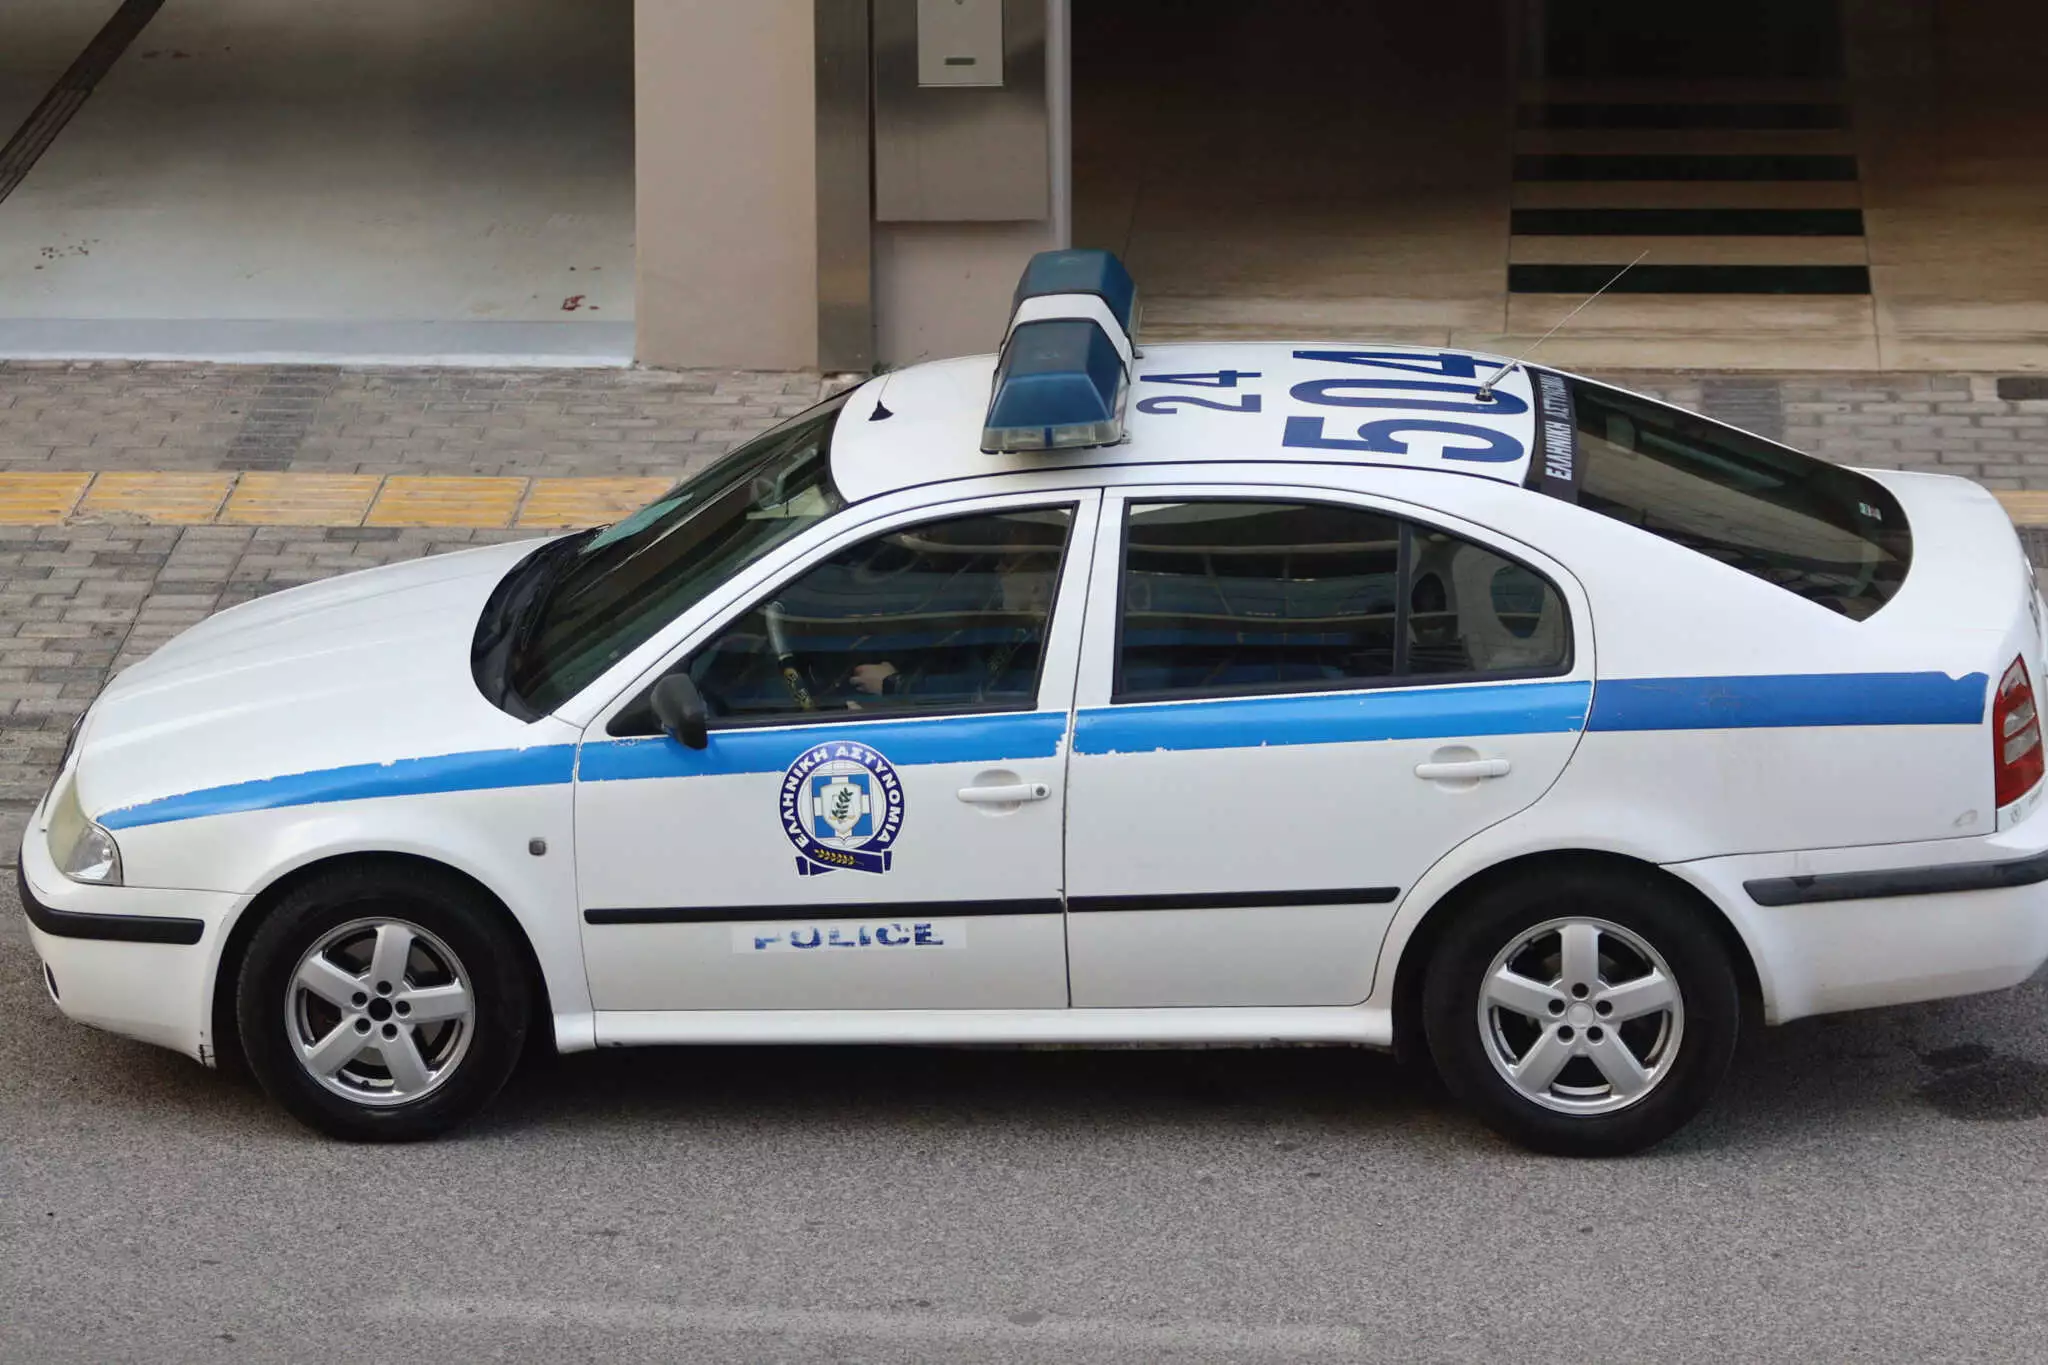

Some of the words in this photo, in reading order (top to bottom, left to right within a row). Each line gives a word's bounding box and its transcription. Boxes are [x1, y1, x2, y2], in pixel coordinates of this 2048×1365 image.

[1136, 370, 1262, 415] 24
[1282, 350, 1528, 463] 504
[1544, 420, 1572, 481] ΕΛΛΗΝΙΚΗ
[782, 747, 829, 849] ΕΛΛΗΝΙΚΗ
[834, 745, 901, 843] ΑΣΤΥΝΟΜΙΑ
